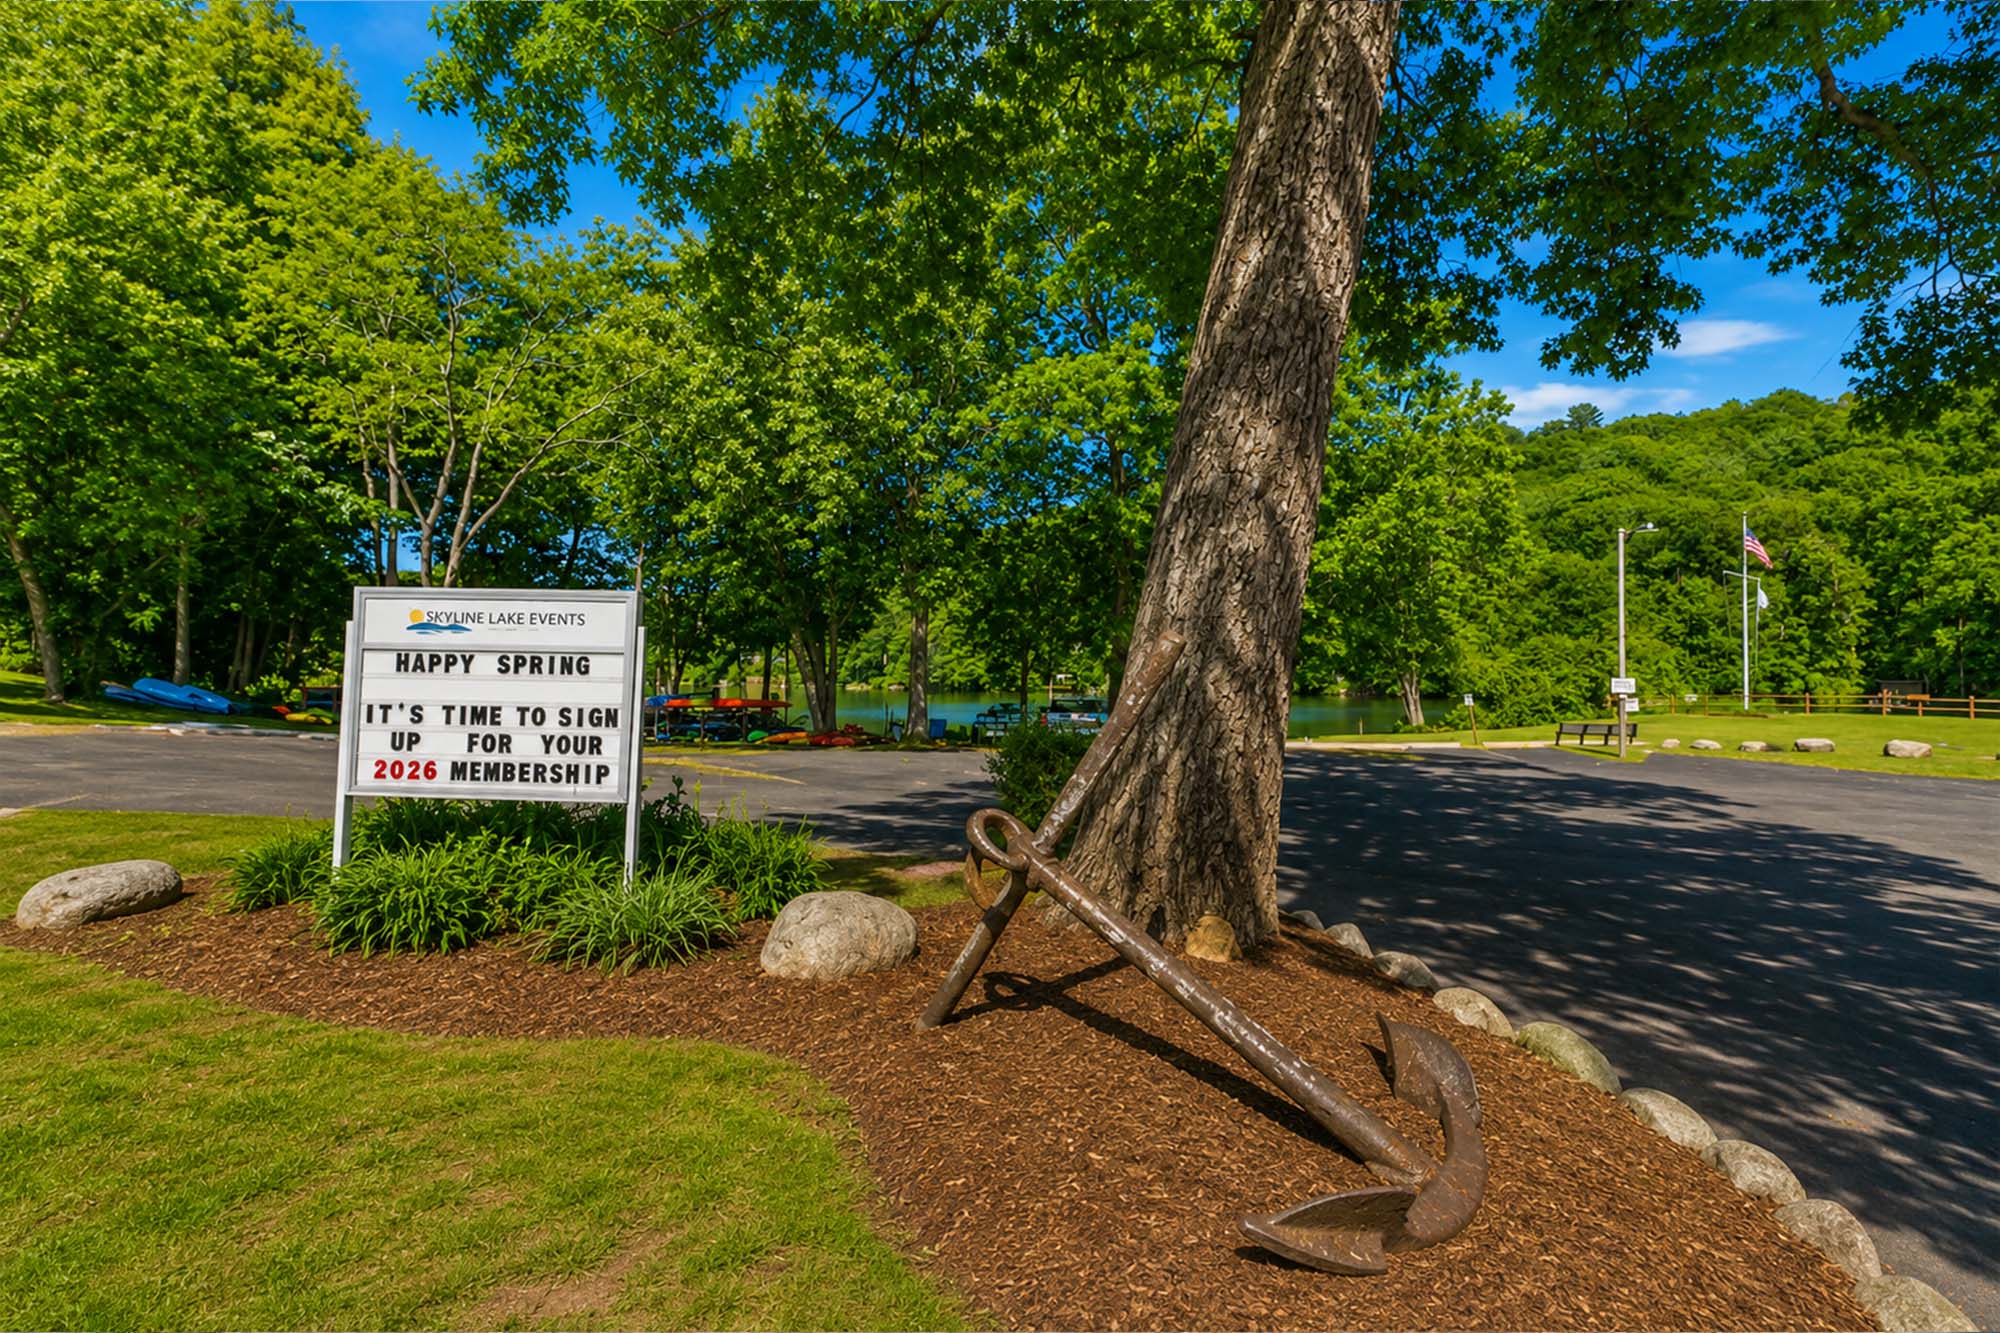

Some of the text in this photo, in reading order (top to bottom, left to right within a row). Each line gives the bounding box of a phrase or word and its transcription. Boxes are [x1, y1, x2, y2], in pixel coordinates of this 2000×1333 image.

[426, 610, 586, 626] SKYLINE LAKE EVENTS
[395, 653, 591, 676] HAPPY SPRING
[366, 703, 619, 728] IT'S TIME TO SIGN
[390, 732, 603, 755] UP FOR YOUR
[373, 760, 611, 785] 2026 MEMBERSHIP
